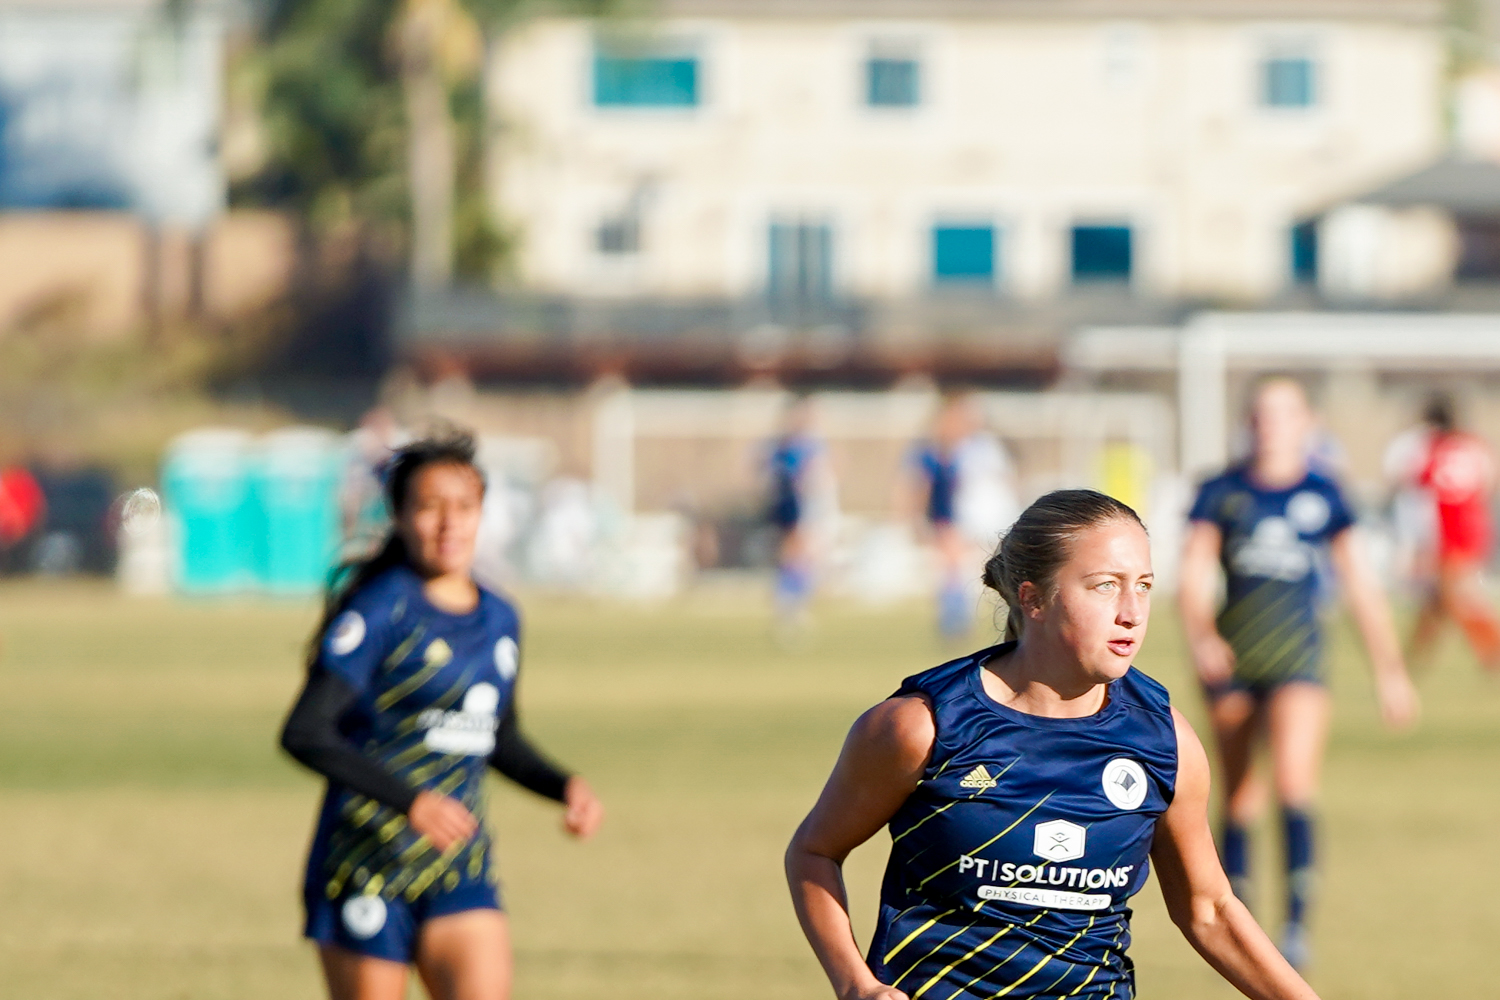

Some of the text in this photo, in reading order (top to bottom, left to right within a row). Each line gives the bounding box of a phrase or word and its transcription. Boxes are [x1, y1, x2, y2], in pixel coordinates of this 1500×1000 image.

[960, 779, 997, 788] adidas
[1000, 863, 1129, 889] SOLUTIONS
[985, 889, 1105, 907] PHYSICAL THERAPY
